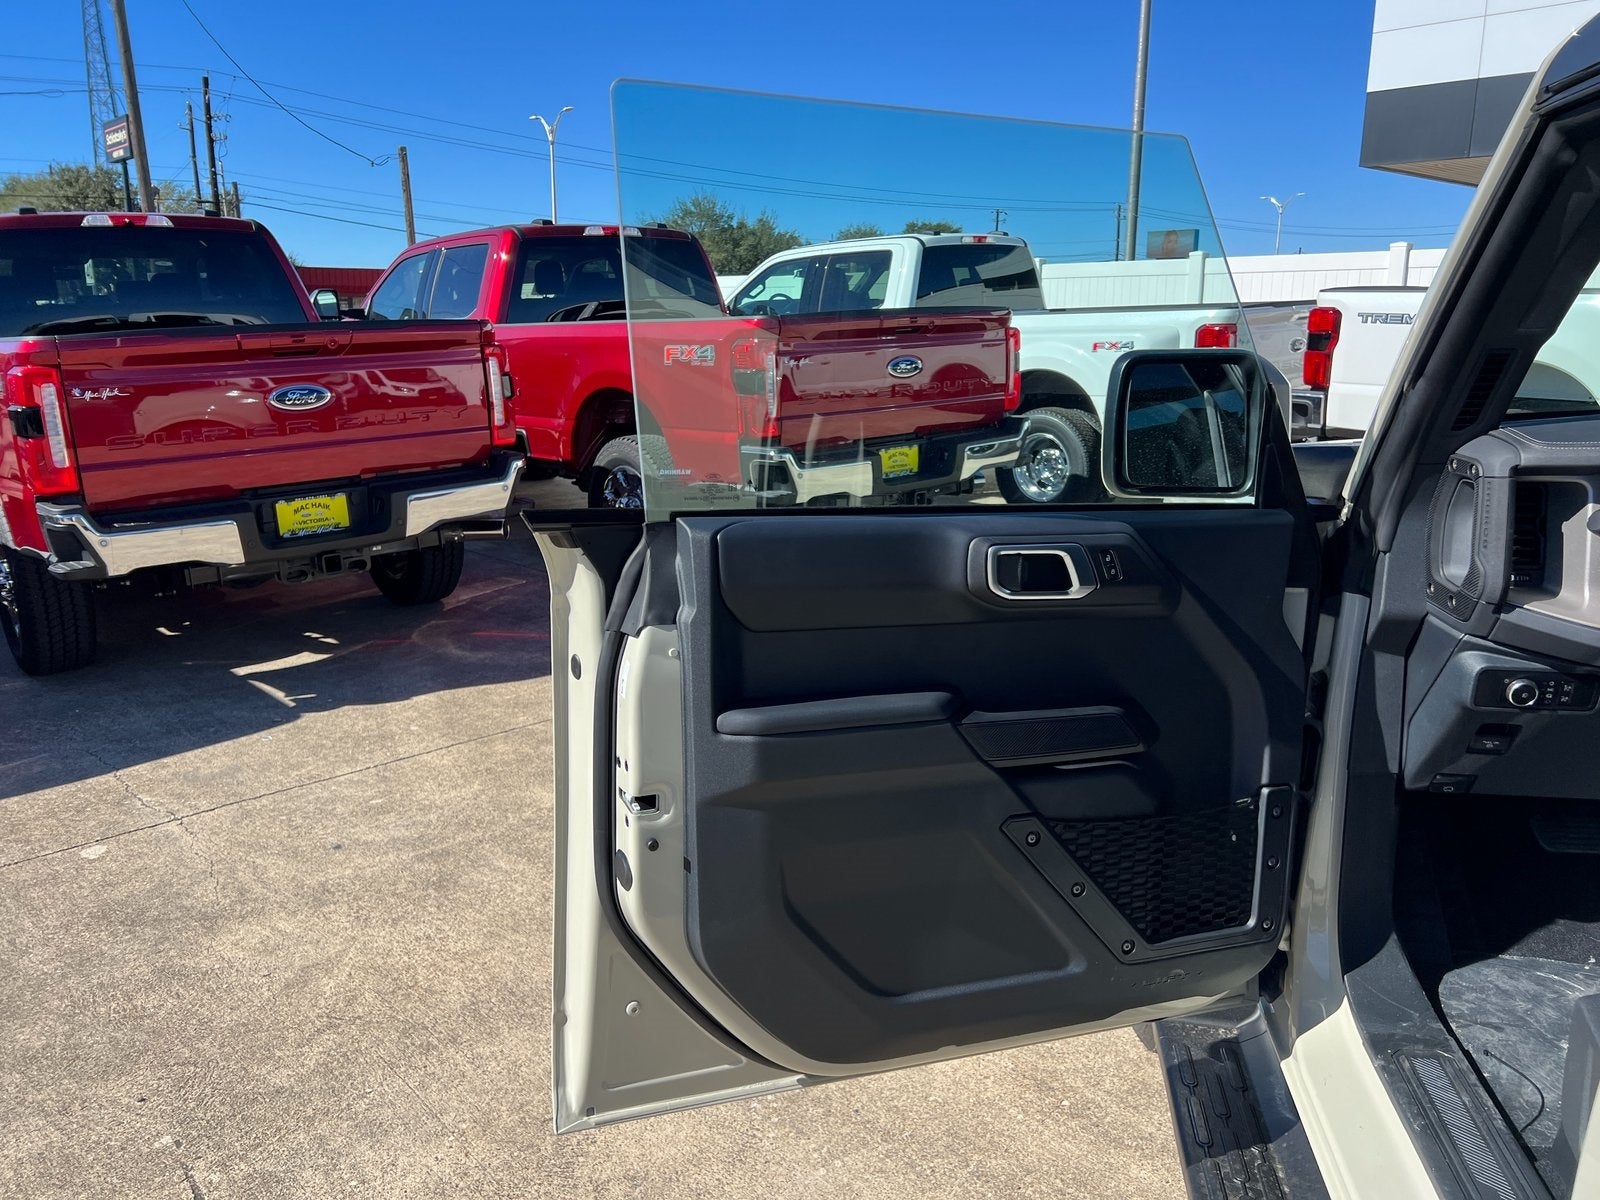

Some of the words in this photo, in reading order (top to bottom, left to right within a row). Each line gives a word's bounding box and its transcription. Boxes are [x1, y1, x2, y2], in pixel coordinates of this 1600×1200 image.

[1091, 340, 1135, 353] FX4
[664, 344, 716, 366] FX4
[921, 376, 997, 394] DUTY
[284, 390, 318, 405] Ford
[293, 502, 310, 514] MAC
[311, 502, 331, 511] HAIK
[298, 516, 330, 526] VICTORIA
